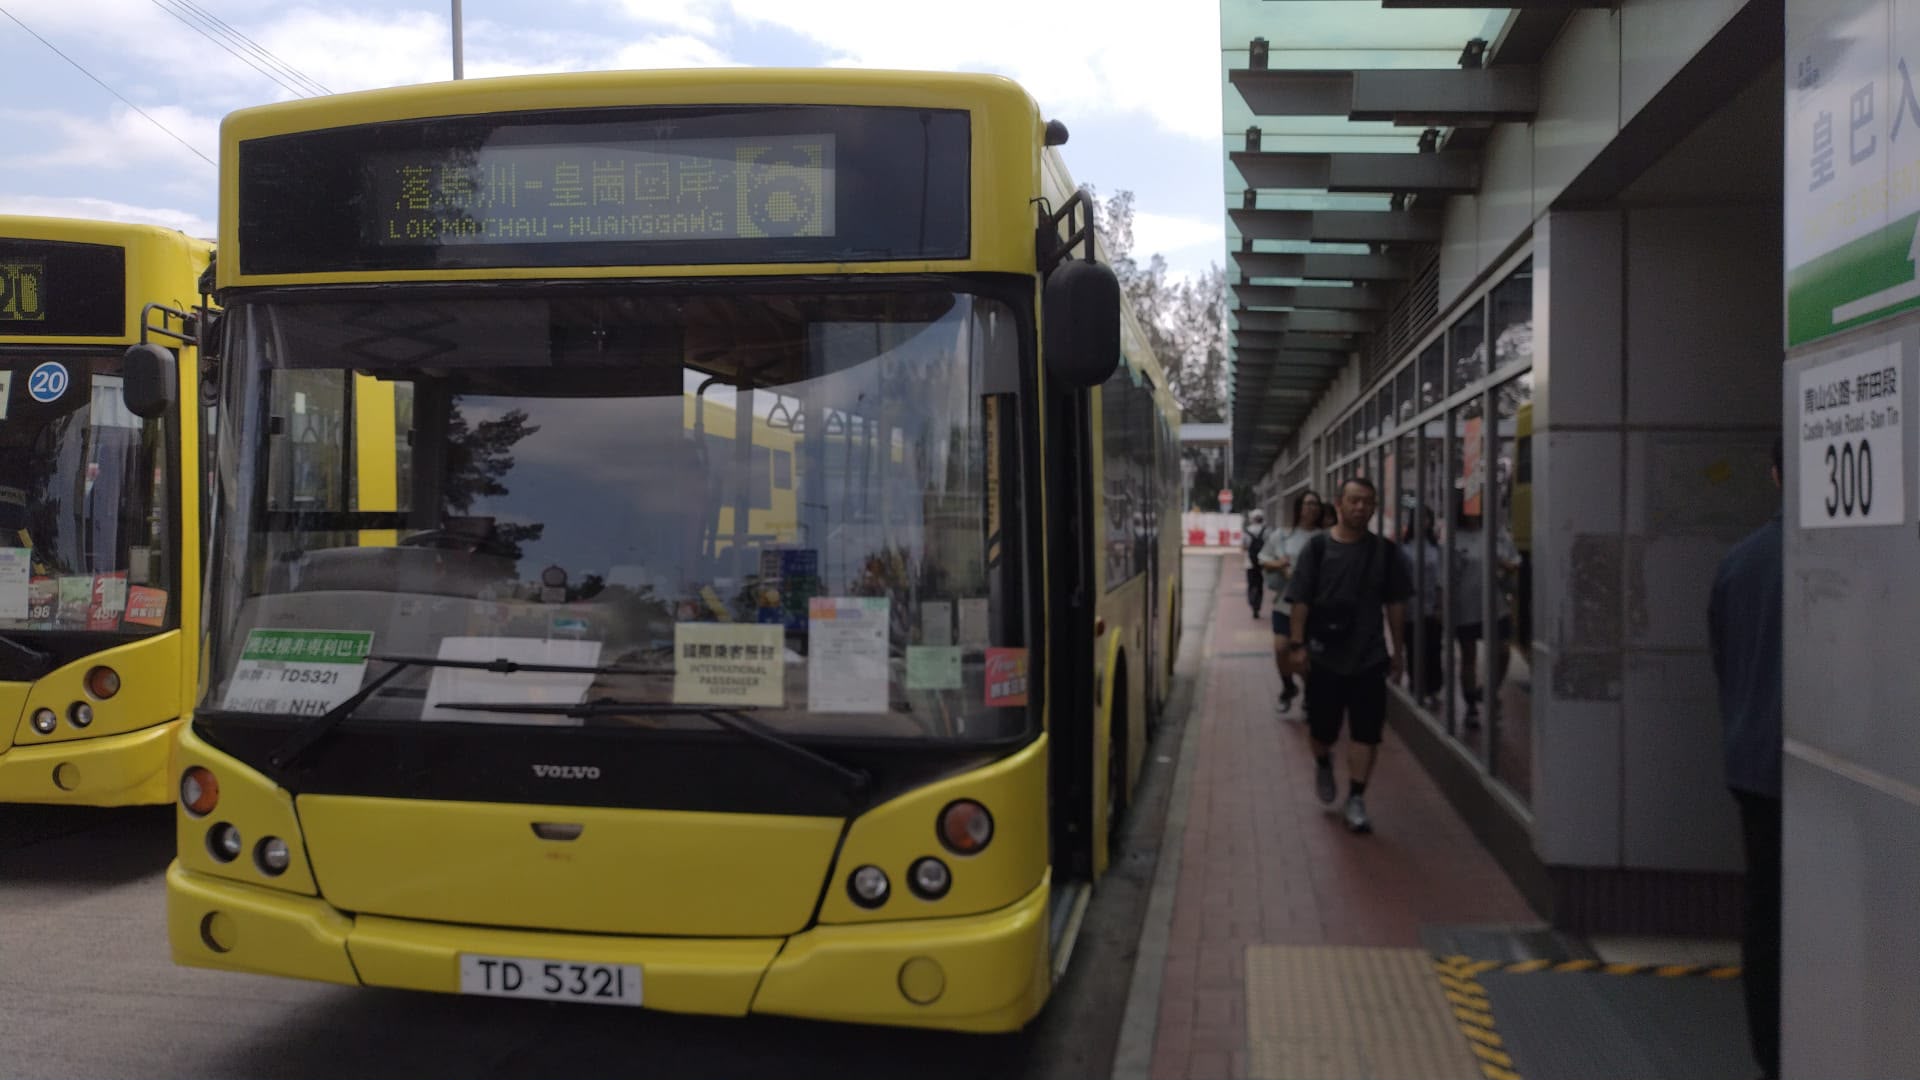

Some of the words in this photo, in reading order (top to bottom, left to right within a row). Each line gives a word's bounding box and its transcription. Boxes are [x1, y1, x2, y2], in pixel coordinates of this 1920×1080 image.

[33, 371, 65, 393] 20
[1845, 411, 1865, 433] Road
[1871, 409, 1885, 429] San
[1825, 438, 1872, 517] 300
[280, 668, 339, 685] TD5321
[689, 663, 767, 675] INTERNATIONAL
[699, 676, 759, 686] PASSENGER
[709, 687, 747, 696] SERVICE
[289, 699, 330, 716] NHK
[532, 764, 601, 779] VOLVO
[478, 960, 522, 991] TD
[543, 964, 624, 997] 5321
